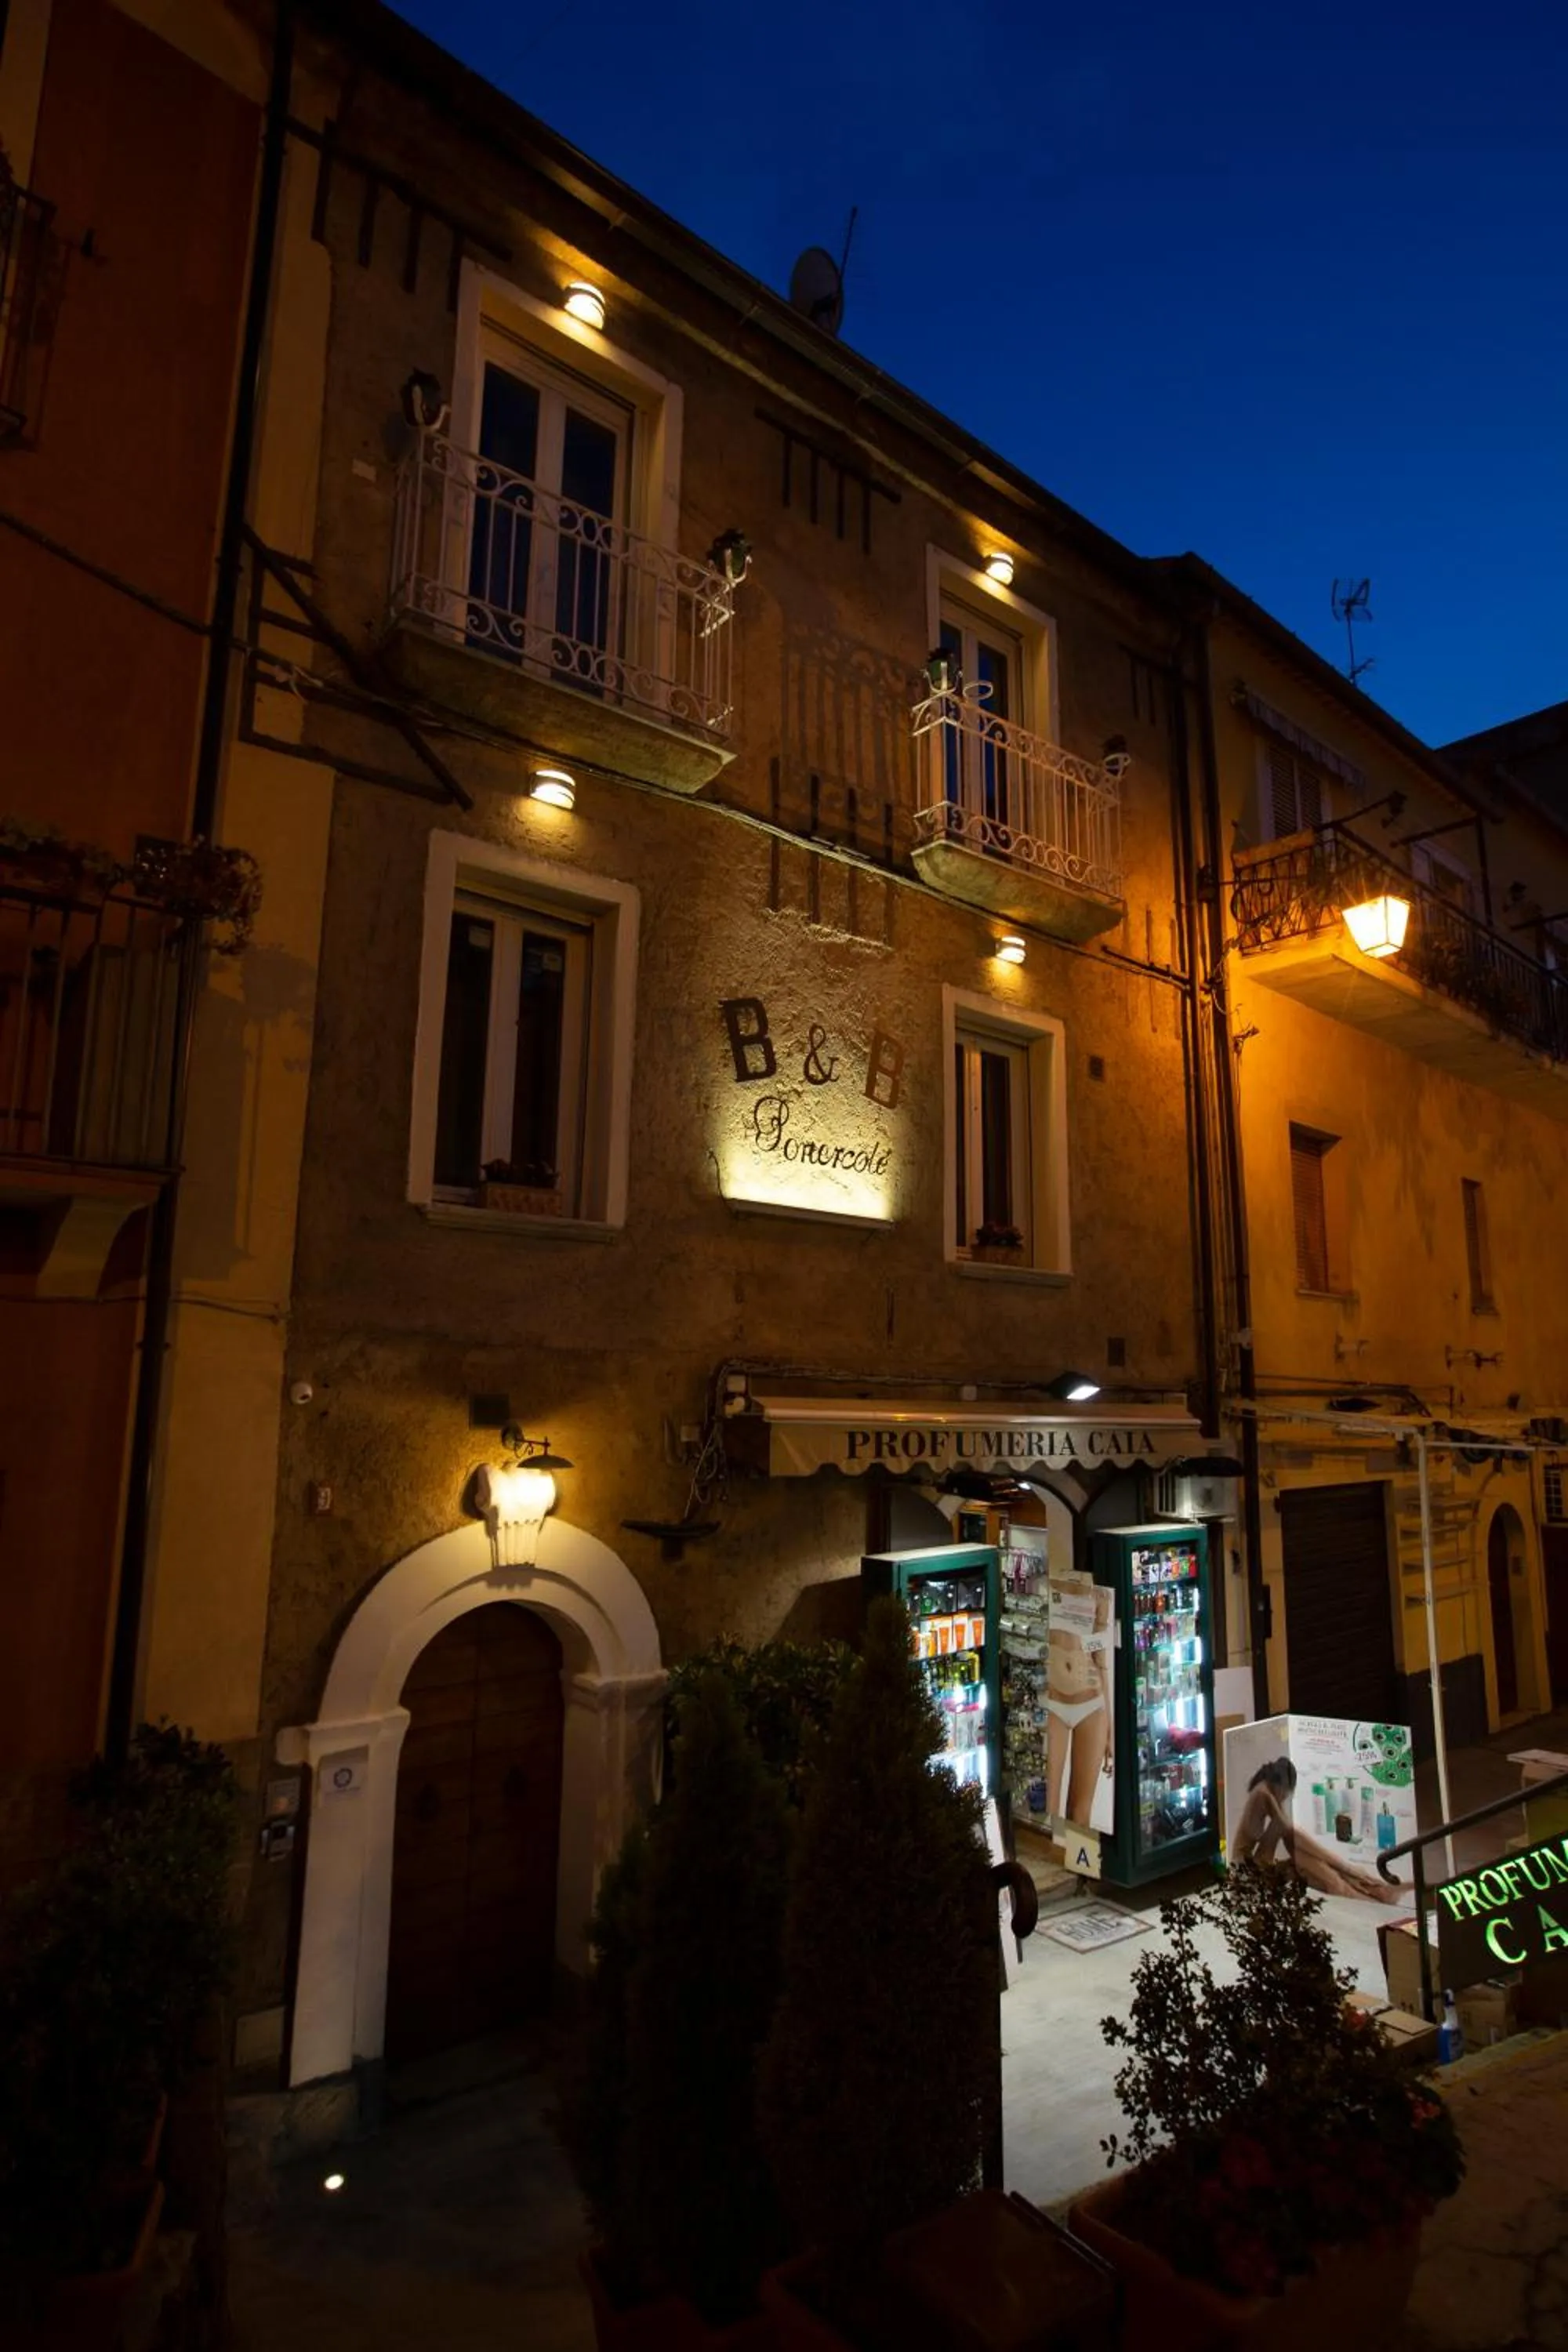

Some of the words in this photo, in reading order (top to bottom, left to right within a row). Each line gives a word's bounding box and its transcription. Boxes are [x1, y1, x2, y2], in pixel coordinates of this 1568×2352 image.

[719, 997, 777, 1083] B
[803, 1024, 840, 1085] &
[864, 1031, 905, 1109] B
[847, 1430, 1076, 1460] PROFUMERIA
[1087, 1430, 1156, 1456] CAIA
[1076, 1846, 1091, 1868] A
[1439, 1838, 1568, 1922] PROFUM
